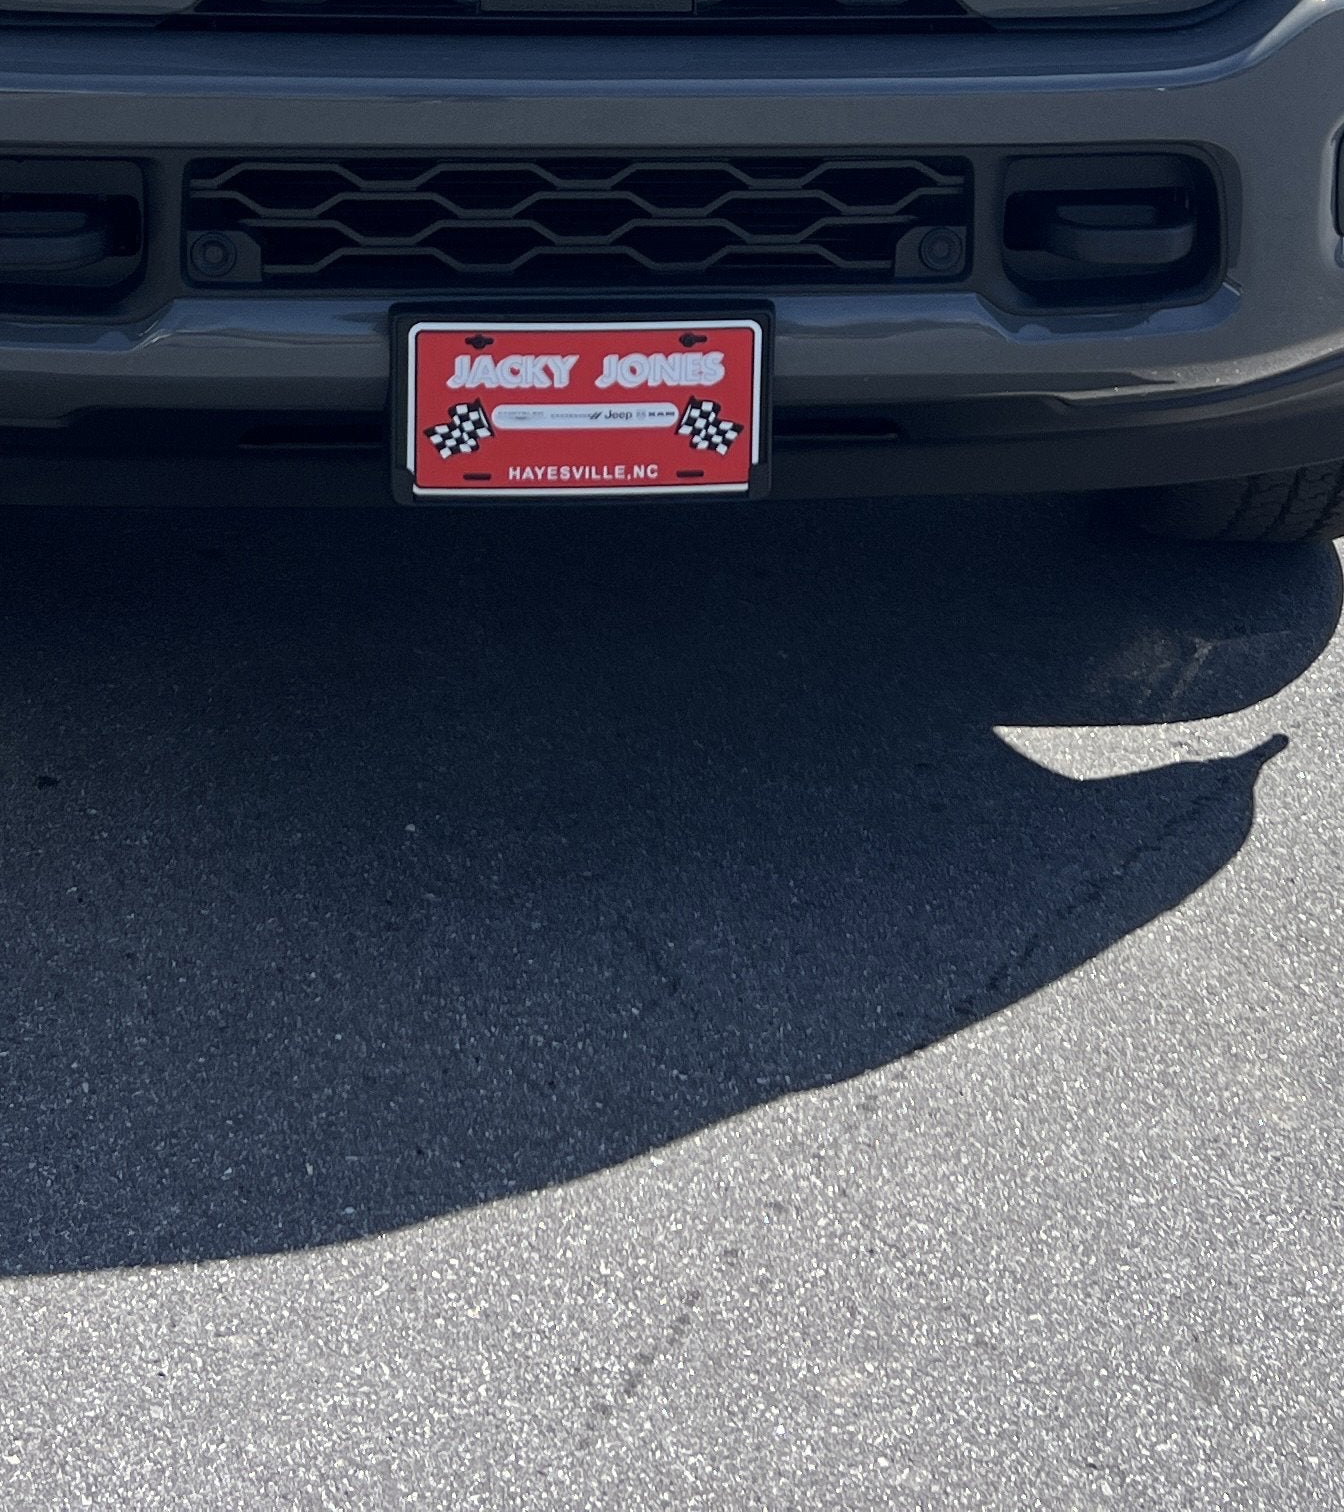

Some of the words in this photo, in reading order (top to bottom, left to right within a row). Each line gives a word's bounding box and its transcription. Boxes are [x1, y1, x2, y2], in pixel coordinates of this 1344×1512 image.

[446, 353, 579, 388] JACKY
[595, 351, 725, 388] JONES
[604, 409, 633, 420] Jeep
[508, 464, 658, 480] HAYESVILLE,NC
